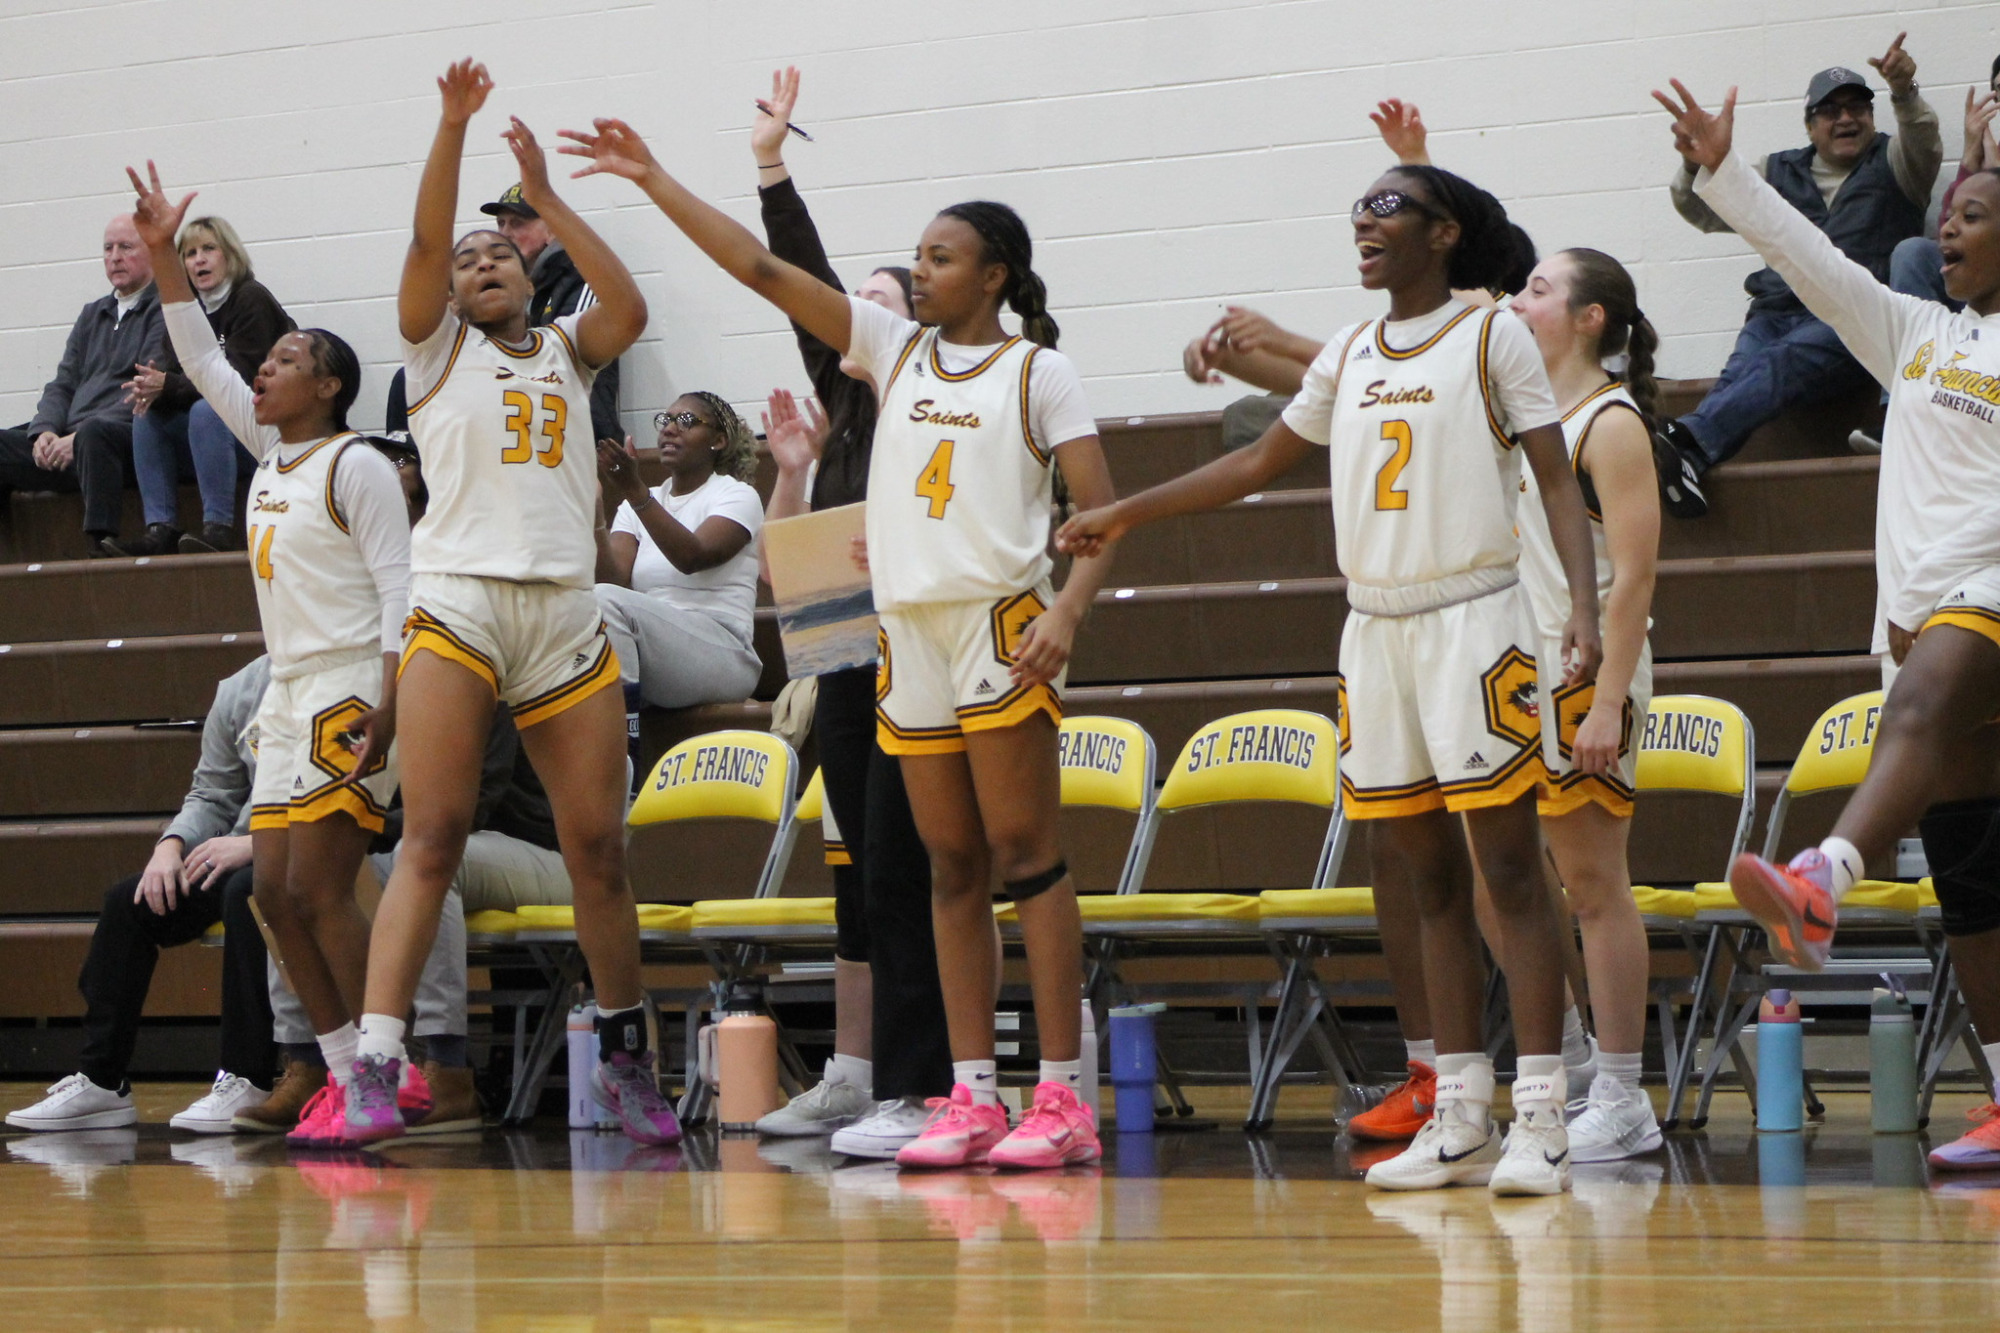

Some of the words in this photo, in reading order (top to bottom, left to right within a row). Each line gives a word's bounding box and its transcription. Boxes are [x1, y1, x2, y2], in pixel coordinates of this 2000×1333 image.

[1358, 379, 1435, 408] Saints
[1930, 350, 2000, 406] Franci
[501, 389, 568, 468] 33
[909, 399, 981, 428] Saints
[1931, 390, 1994, 424] BASKETBALL
[915, 439, 955, 520] 4
[1375, 419, 1412, 511] 2
[1059, 731, 1126, 775] RANCIS
[1188, 731, 1220, 772] ST.
[1227, 725, 1316, 770] FRANCIS
[1641, 713, 1722, 758] RANCIS
[1820, 711, 1854, 755] ST.
[656, 752, 687, 791] ST.
[691, 746, 769, 788] FRANCIS
